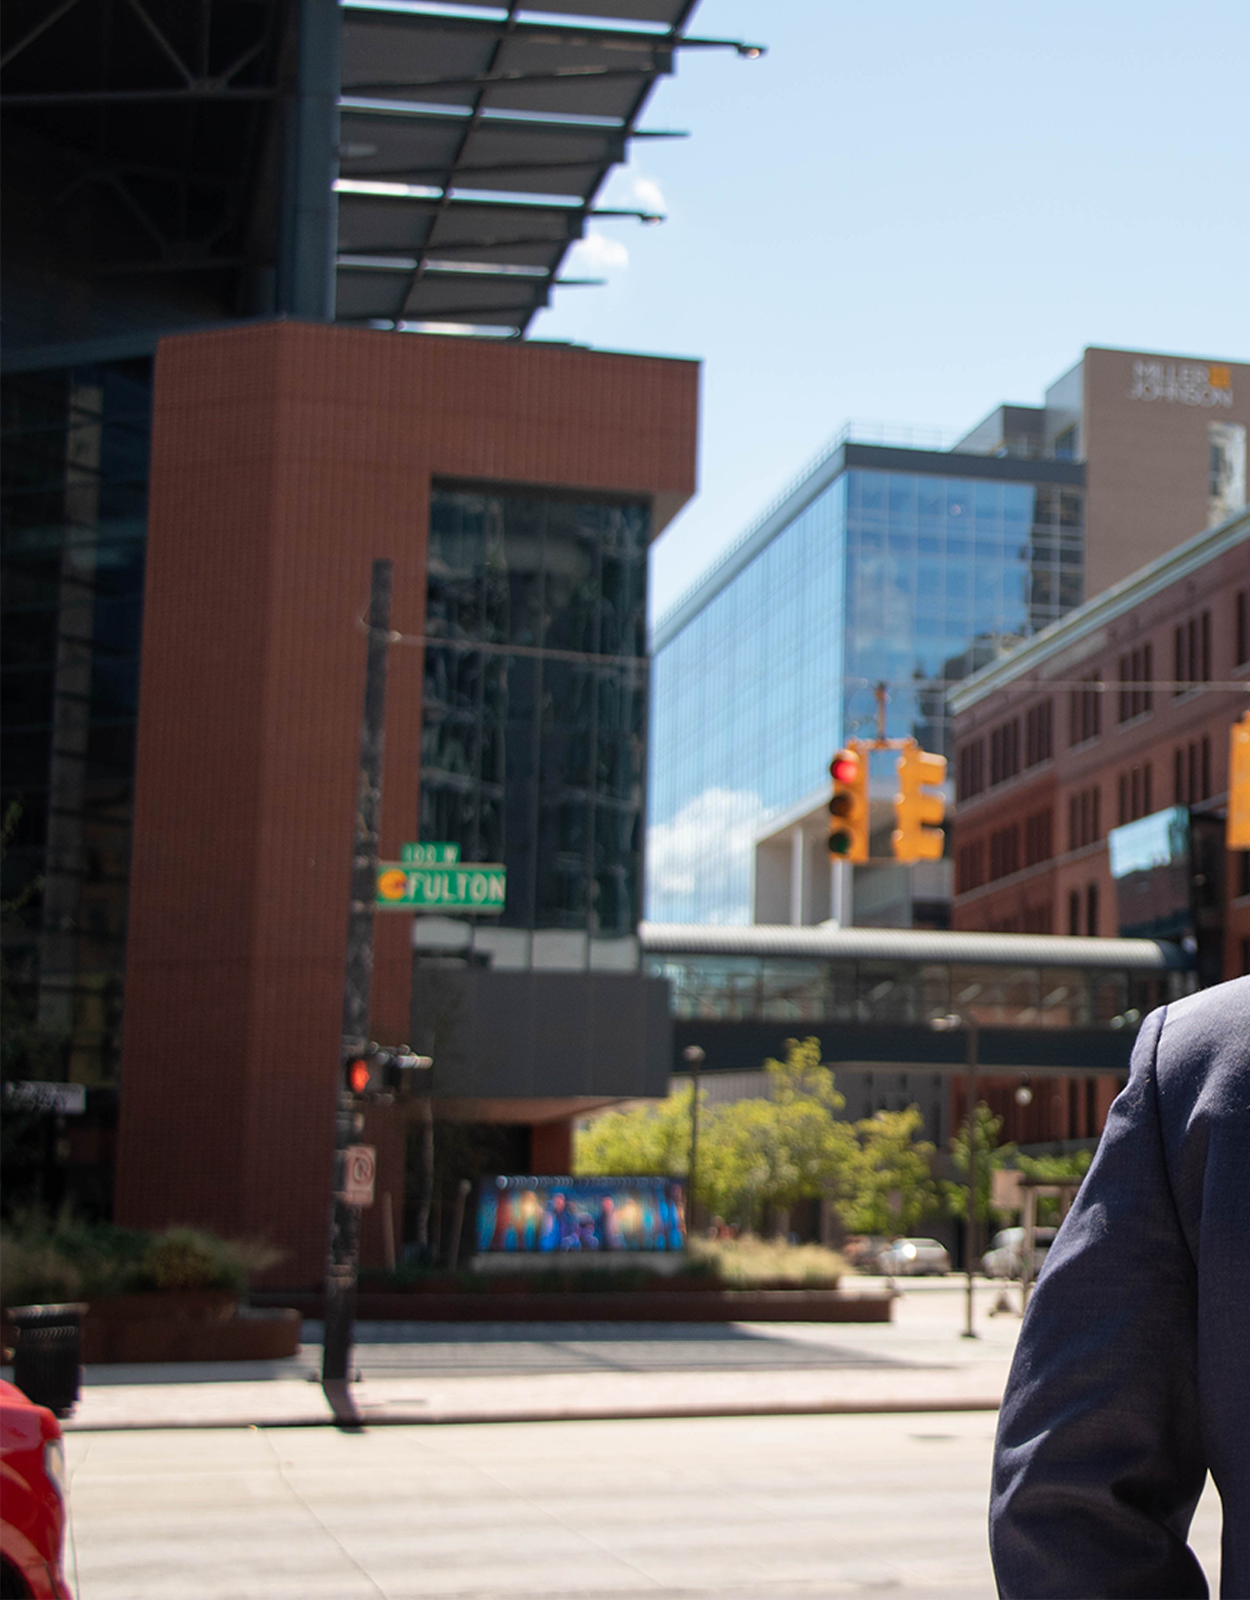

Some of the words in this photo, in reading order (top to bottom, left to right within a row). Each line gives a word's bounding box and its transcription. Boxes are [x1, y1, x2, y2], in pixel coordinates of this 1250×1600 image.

[1132, 361, 1210, 386] MILLER
[1126, 383, 1233, 408] JOHNSON
[443, 844, 459, 864] W
[407, 870, 506, 902] FULTON
